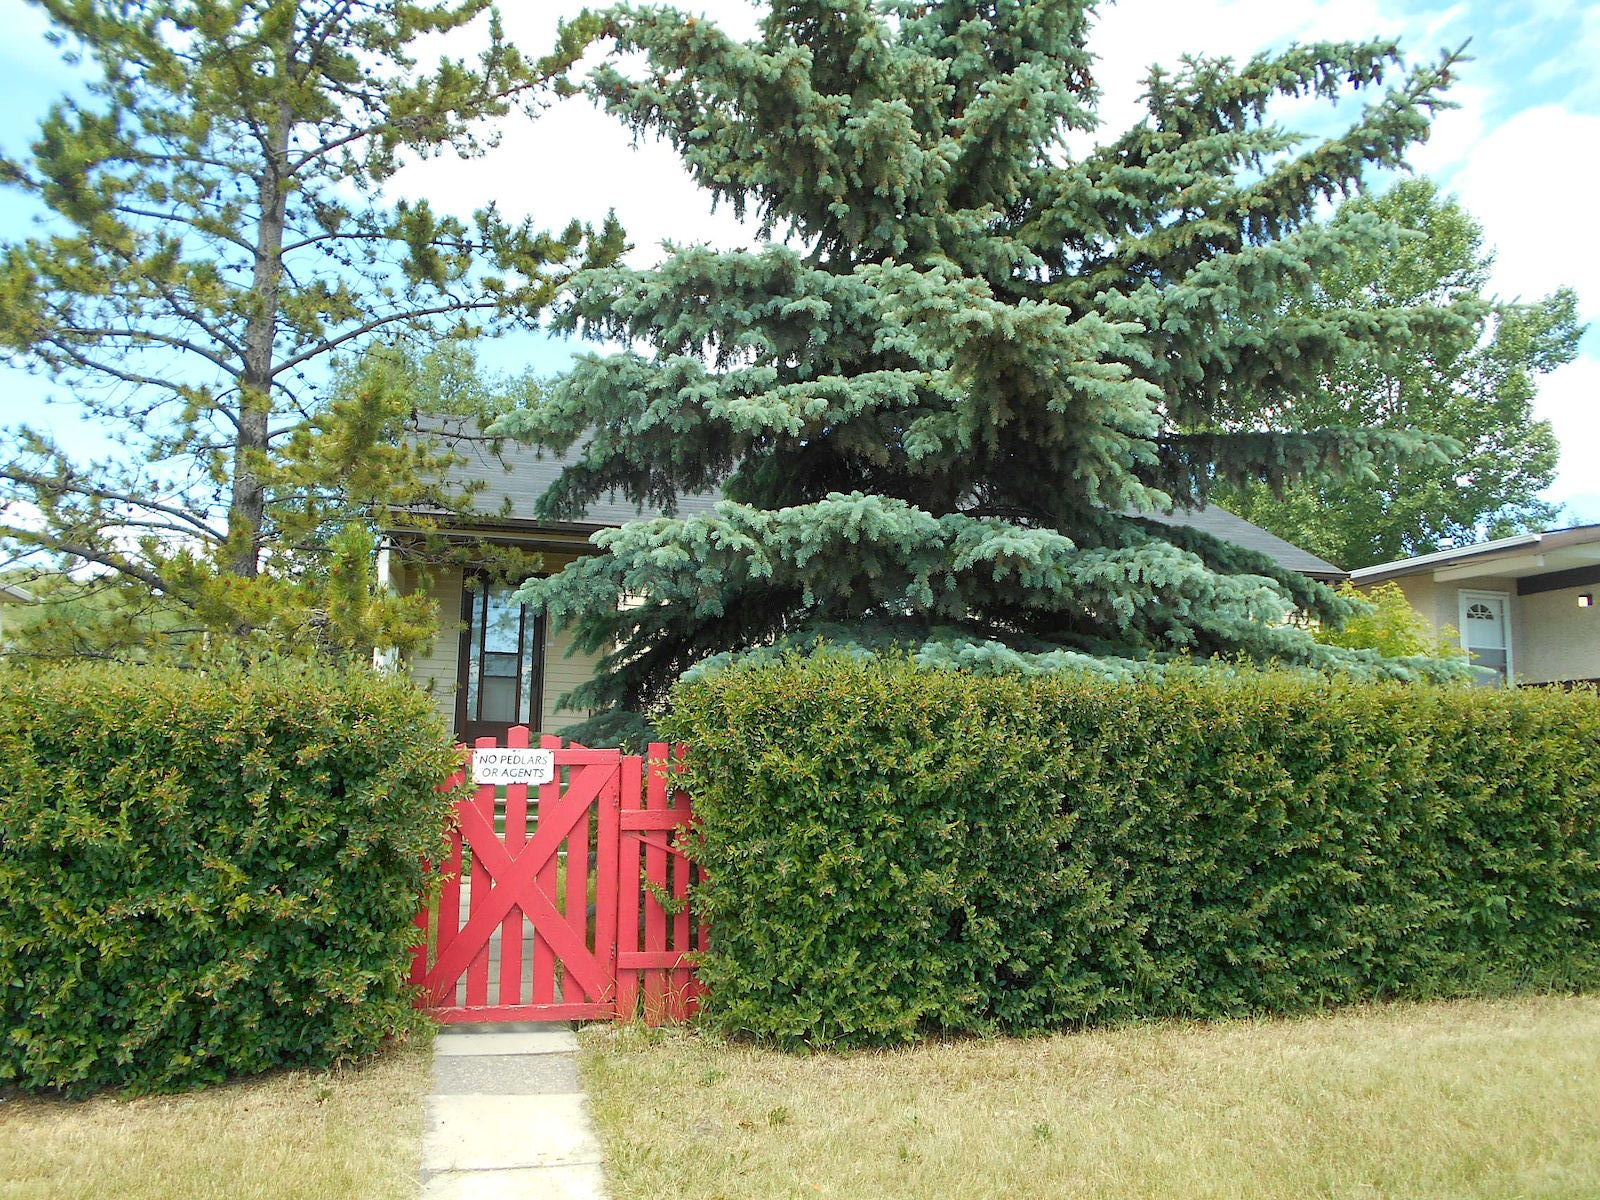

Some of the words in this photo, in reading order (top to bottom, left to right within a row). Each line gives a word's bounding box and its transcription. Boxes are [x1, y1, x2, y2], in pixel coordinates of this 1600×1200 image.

[479, 754, 497, 764] NO
[500, 755, 548, 765] PEDLARS
[482, 767, 499, 777] OR
[501, 768, 545, 777] AGENTS
